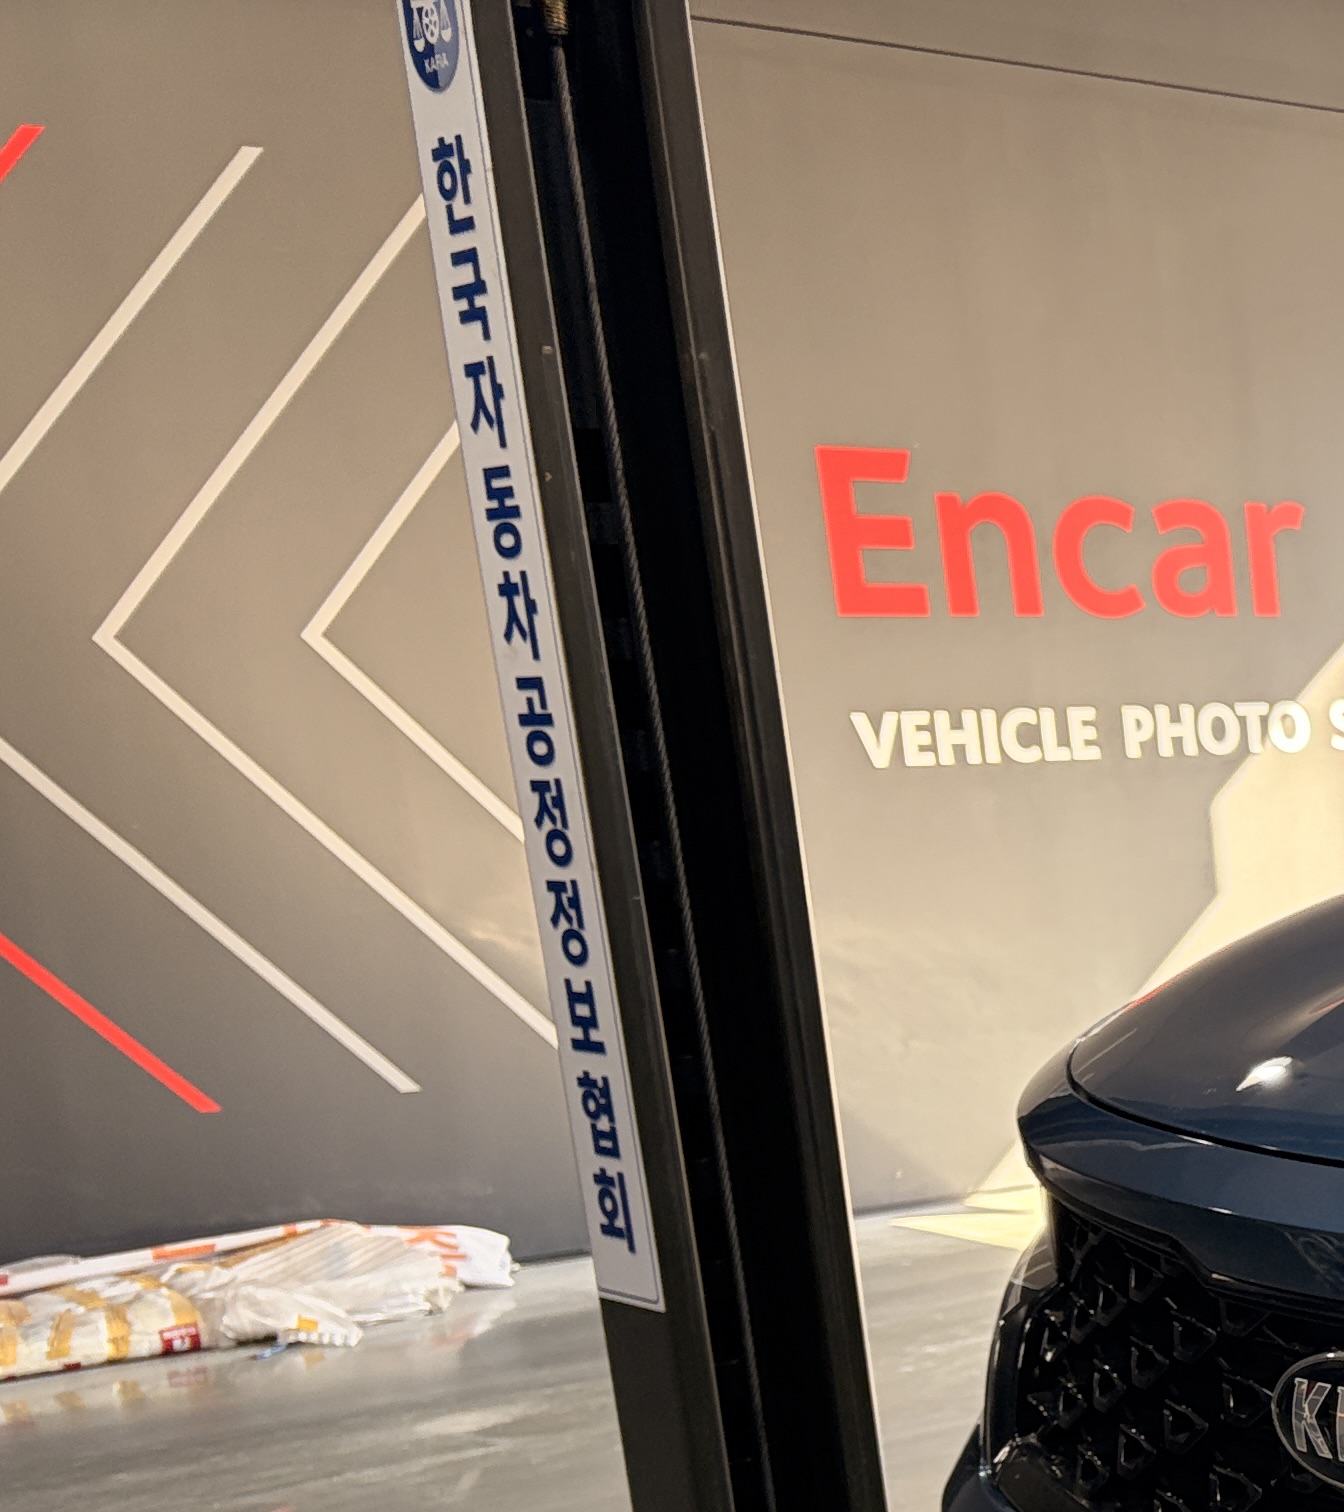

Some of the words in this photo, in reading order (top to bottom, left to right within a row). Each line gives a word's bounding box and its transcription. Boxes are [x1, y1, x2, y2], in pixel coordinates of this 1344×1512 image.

[813, 444, 1305, 619] Encar
[849, 705, 1102, 769] VEHICLE
[1121, 700, 1312, 759] PHOTO
